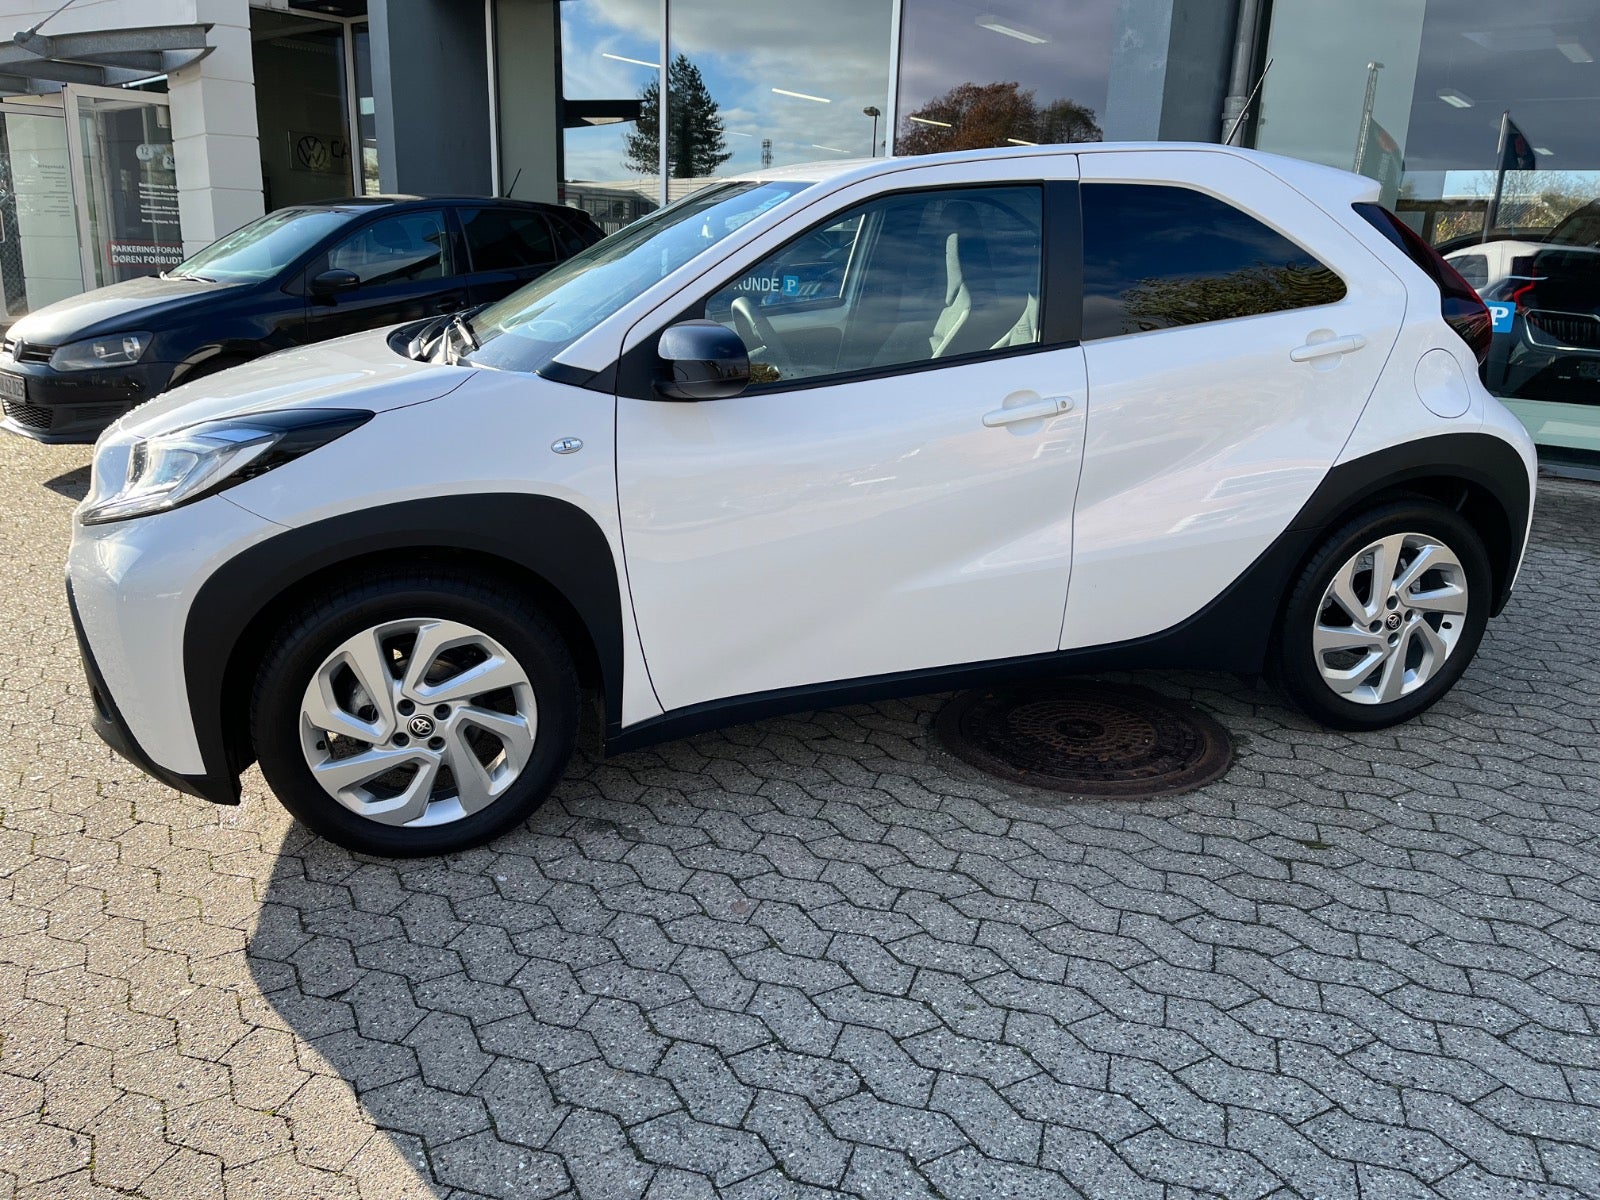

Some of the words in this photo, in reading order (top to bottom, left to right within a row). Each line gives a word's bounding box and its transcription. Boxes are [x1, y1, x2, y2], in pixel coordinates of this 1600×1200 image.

[111, 244, 155, 254] PARKERING
[156, 246, 183, 255] FORAN
[112, 255, 142, 264] DØREN
[143, 255, 183, 265] FORBUDT
[1489, 306, 1509, 326] P
